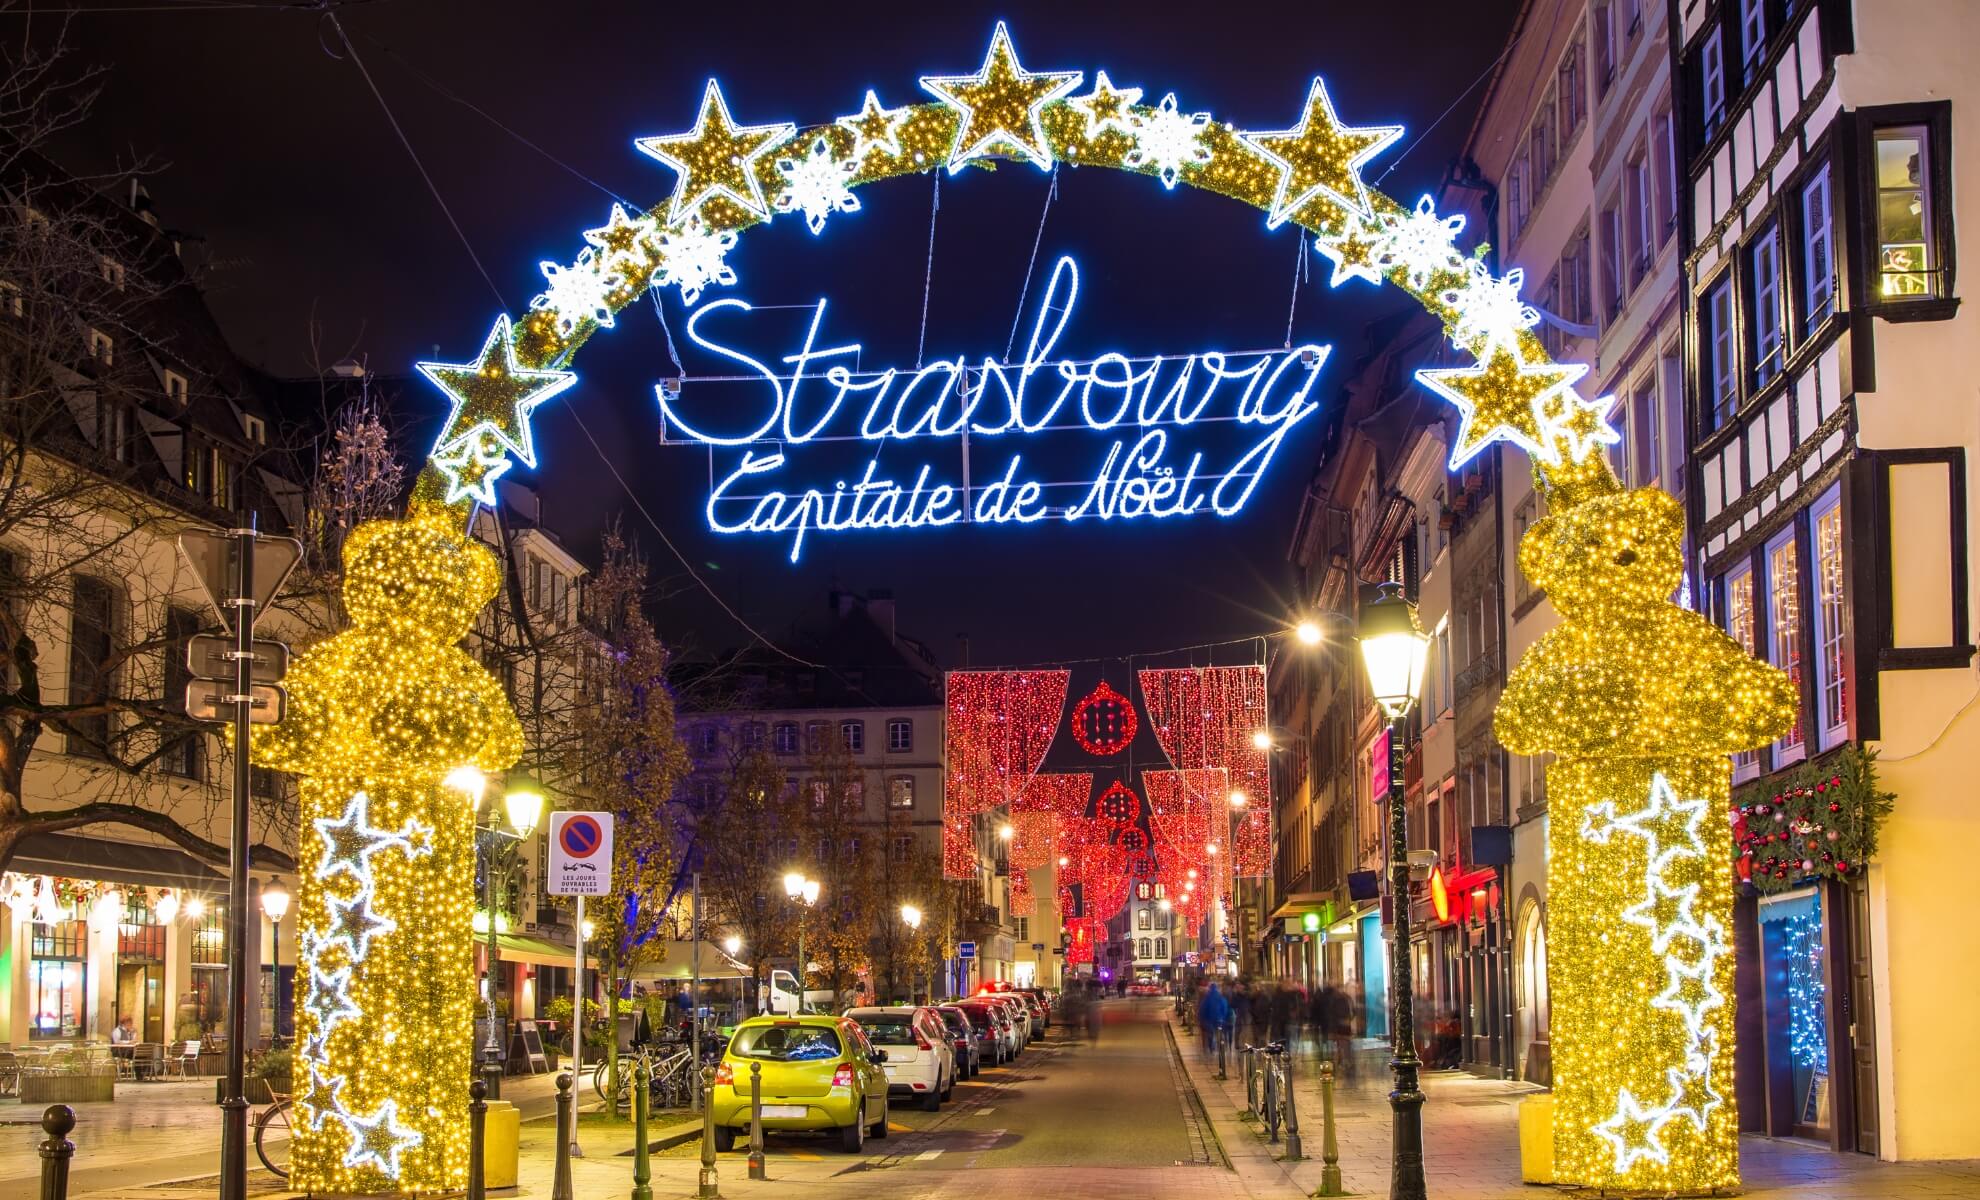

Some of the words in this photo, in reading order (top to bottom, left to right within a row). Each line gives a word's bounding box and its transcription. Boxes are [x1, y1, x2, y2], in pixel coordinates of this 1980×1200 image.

[655, 255, 1332, 517] Strasbourg
[706, 450, 960, 563] Capitale
[975, 455, 1047, 523] de
[1064, 429, 1203, 520] Noël
